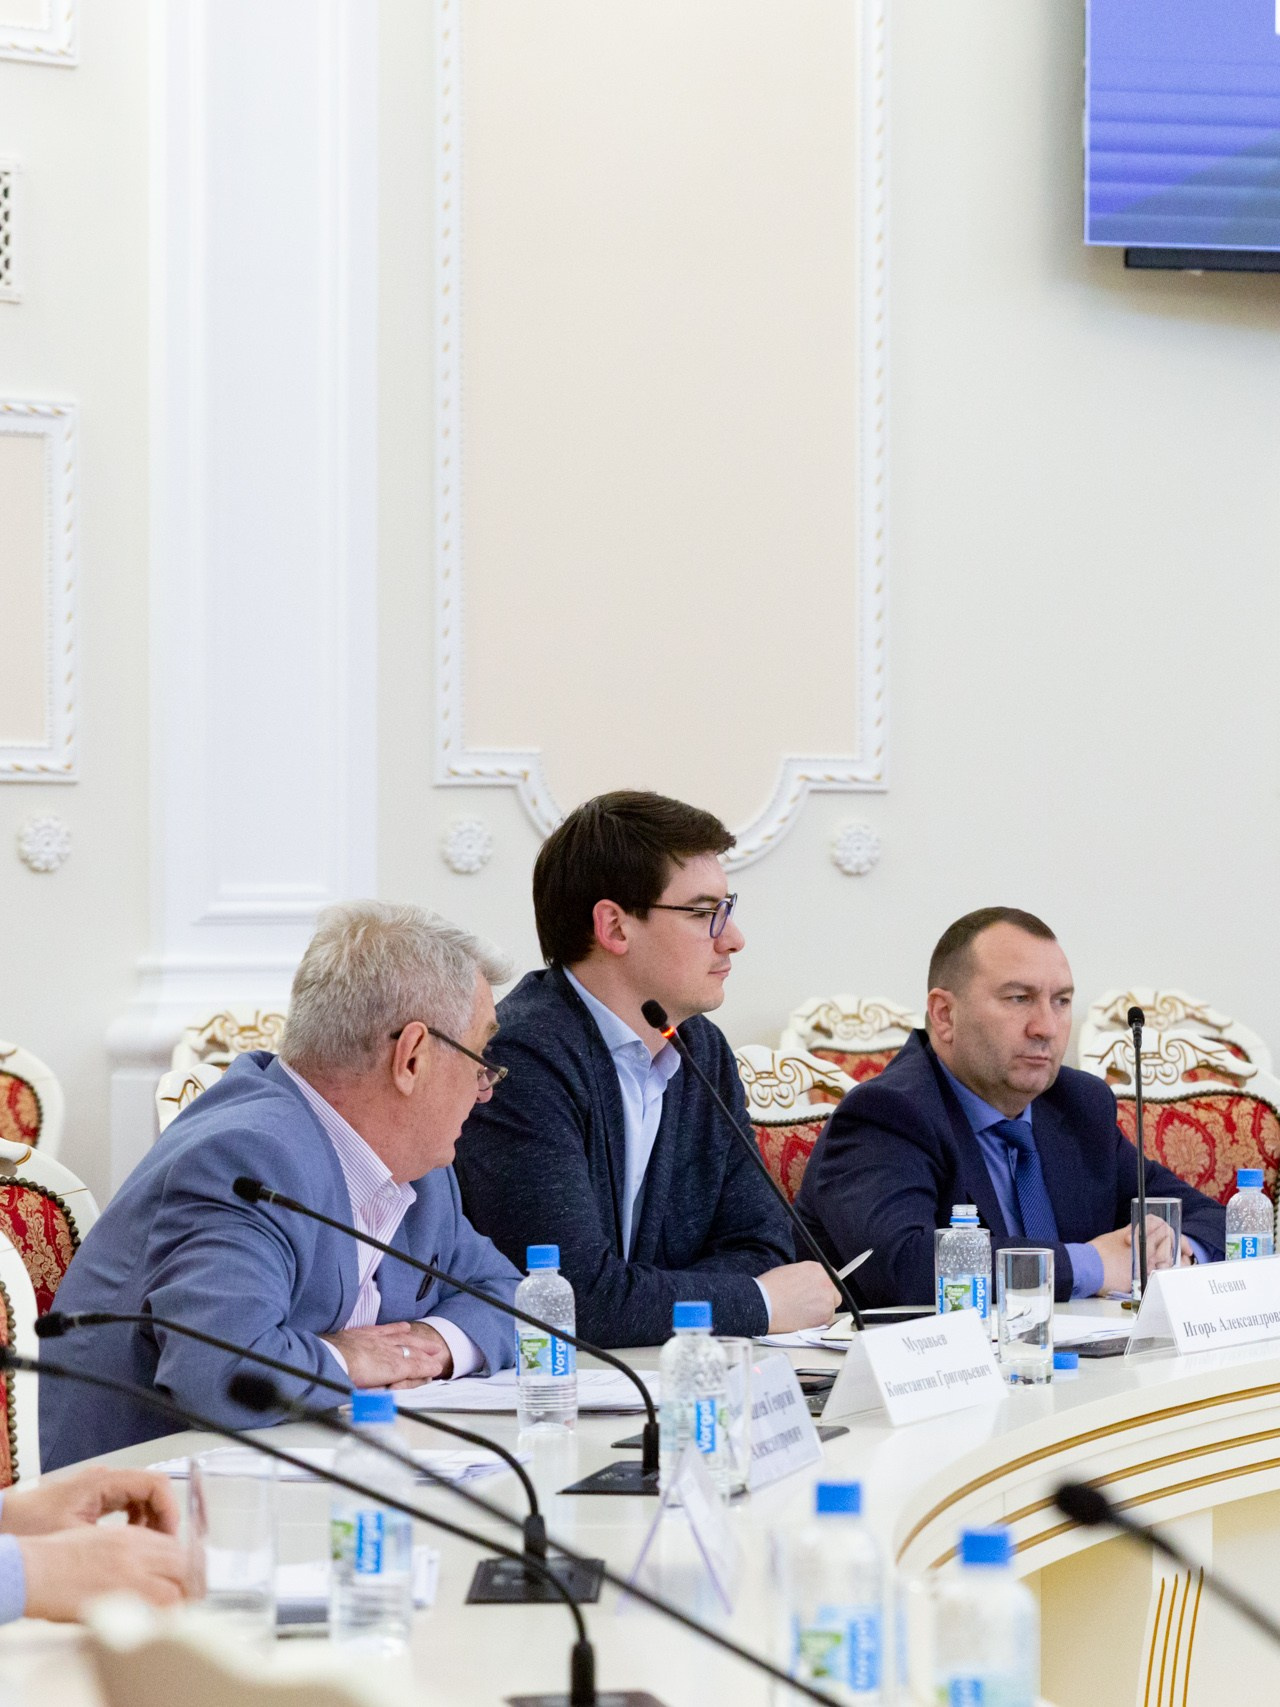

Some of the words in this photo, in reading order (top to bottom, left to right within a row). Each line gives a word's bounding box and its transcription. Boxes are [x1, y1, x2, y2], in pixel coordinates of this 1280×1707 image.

[901, 1334, 948, 1355] Муравьев
[1183, 1321, 1217, 1338] Игорь
[554, 1338, 567, 1375] Vorg
[884, 1376, 939, 1398] Константин
[936, 1364, 992, 1389] Григорьевич
[699, 1400, 714, 1451] Vorgol
